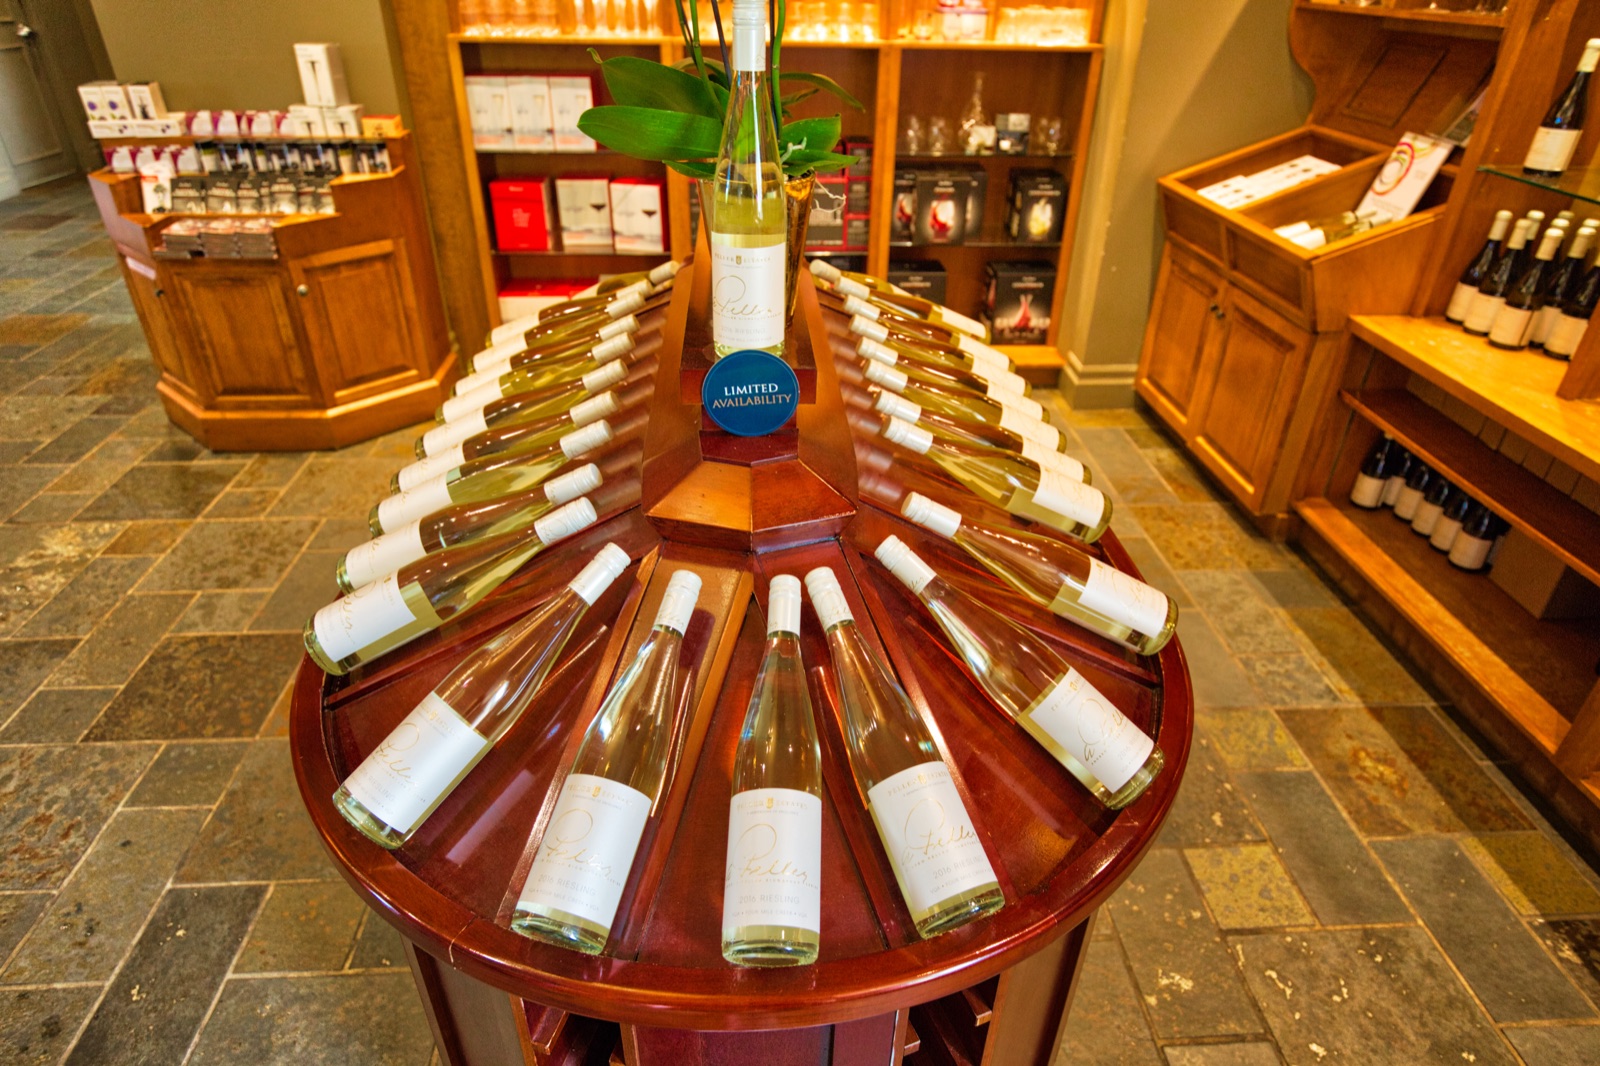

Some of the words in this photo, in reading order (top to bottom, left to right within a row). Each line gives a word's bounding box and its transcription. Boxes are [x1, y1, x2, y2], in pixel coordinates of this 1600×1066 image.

[724, 383, 779, 396] LIMITED
[712, 394, 792, 409] AVAILABILITY
[739, 895, 757, 904] 2016
[760, 894, 800, 905] RIESLING
